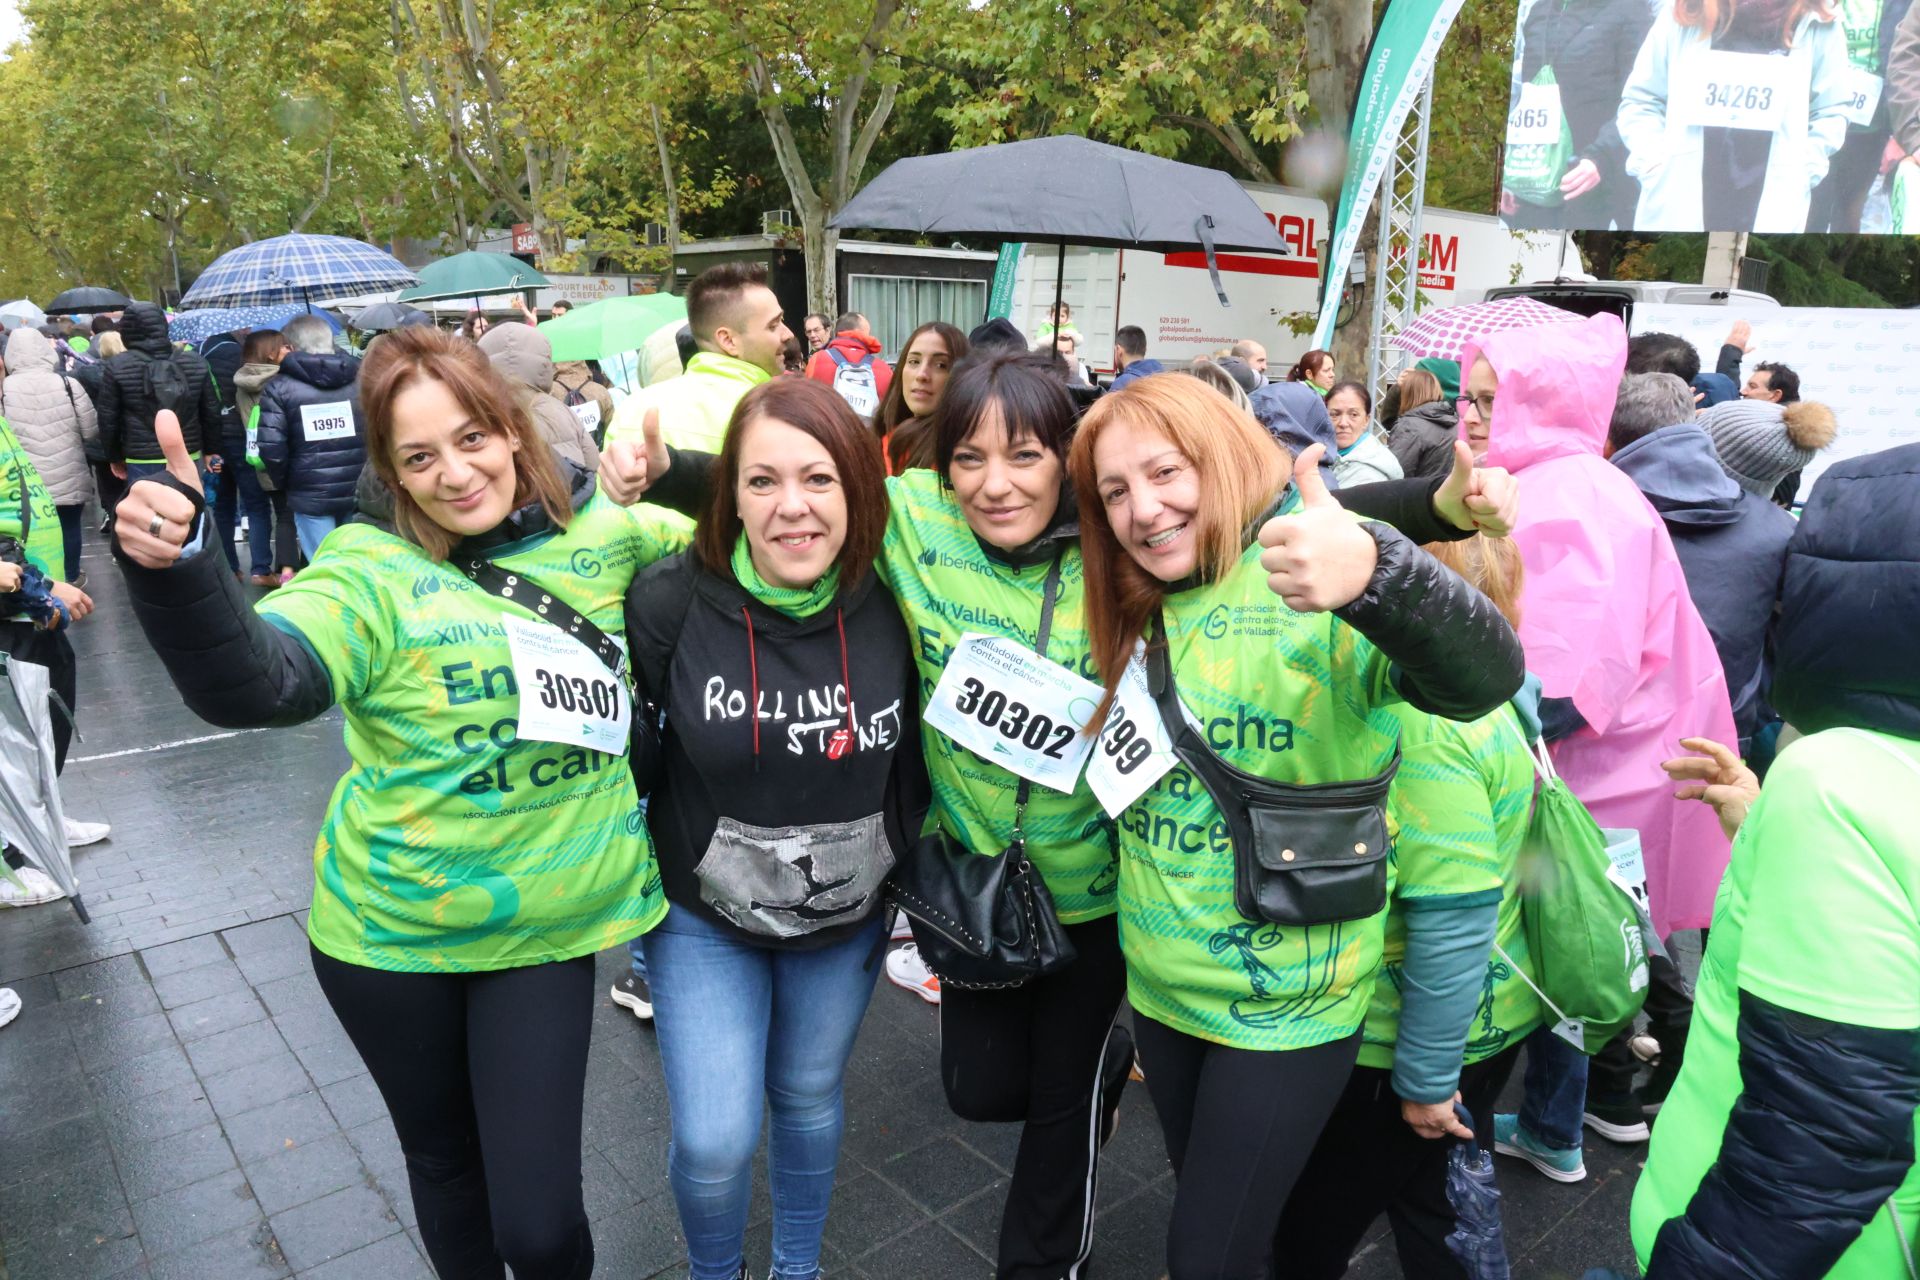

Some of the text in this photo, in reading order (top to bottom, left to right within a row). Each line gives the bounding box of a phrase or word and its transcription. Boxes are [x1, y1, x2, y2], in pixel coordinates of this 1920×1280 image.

[1364, 48, 1392, 123] española
[1705, 82, 1773, 110] 34263
[1508, 108, 1548, 129] 365
[312, 417, 346, 431] 13975
[940, 551, 996, 578] Iberdro
[434, 621, 508, 646] XIII Val
[1233, 615, 1260, 624] contra
[970, 644, 1001, 666] contra
[1012, 666, 1045, 688] cáncer
[974, 637, 1024, 666] Valladolid
[535, 668, 619, 722] 30301
[954, 675, 1077, 761] 30302
[1200, 704, 1294, 753] cha
[1100, 693, 1153, 776] 299
[459, 756, 515, 797] el
[463, 804, 517, 819] ASOCIACIÓN
[517, 796, 561, 815] ESPAÑOLA
[561, 790, 595, 805] CONTRA
[1120, 797, 1232, 854] cánce
[1160, 869, 1195, 879] CÁNCER
